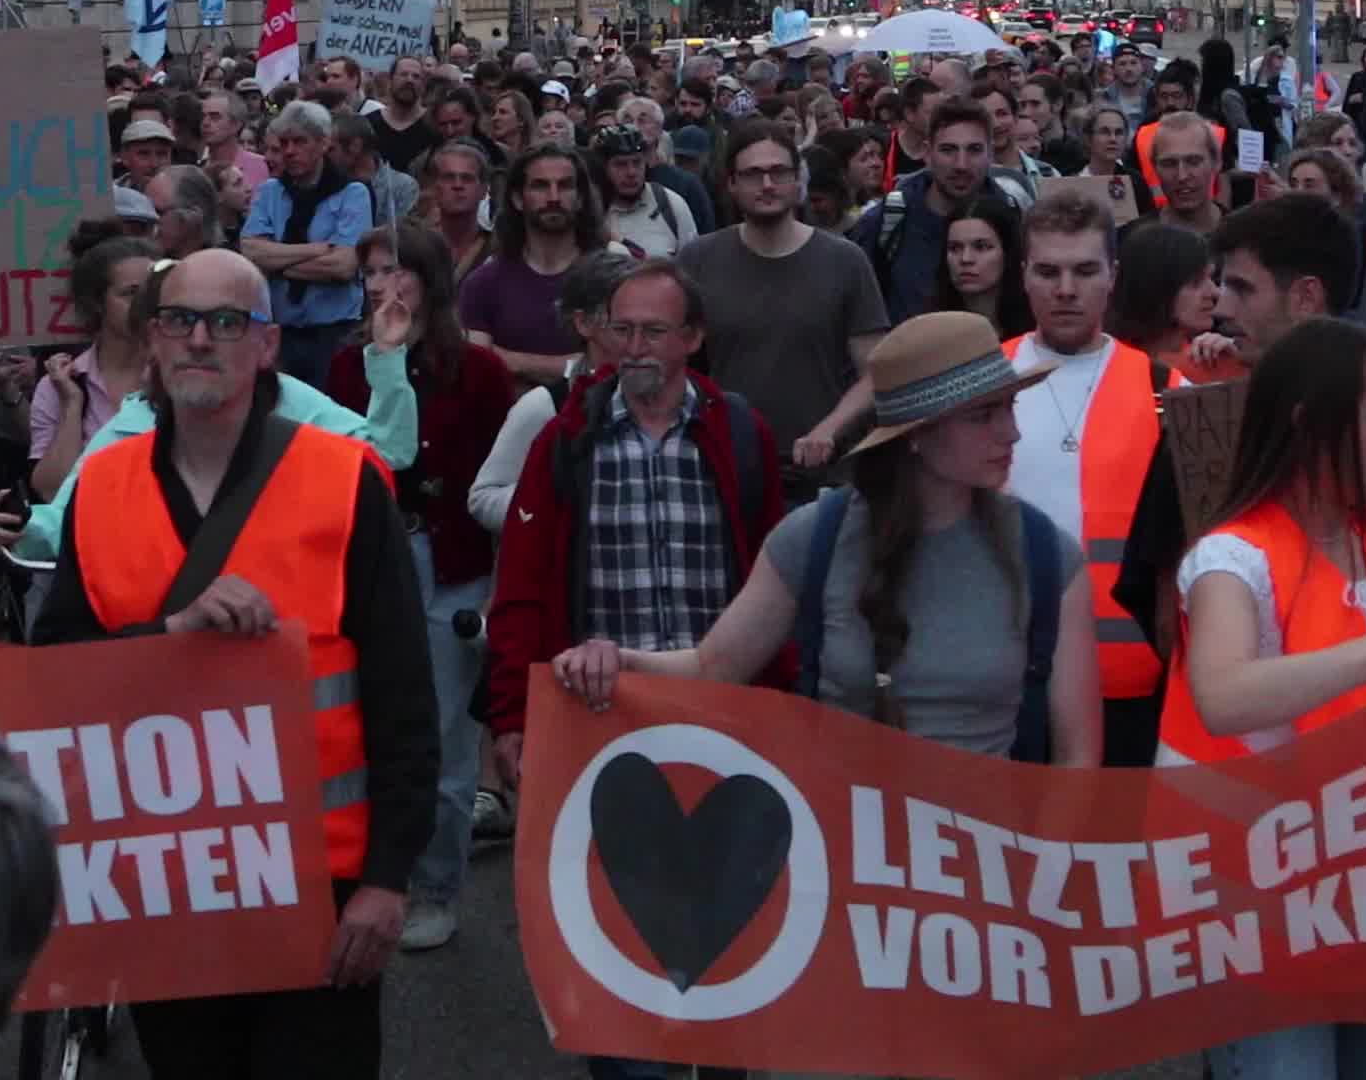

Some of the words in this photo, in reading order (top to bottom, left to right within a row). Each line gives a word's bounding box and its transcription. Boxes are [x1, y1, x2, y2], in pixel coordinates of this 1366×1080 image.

[325, 32, 348, 50] der
[357, 15, 393, 33] schon
[397, 24, 423, 40] mal
[851, 786, 1218, 930] LETZTE
[849, 903, 1052, 1009] VOR
[1071, 911, 1263, 1017] DEN
